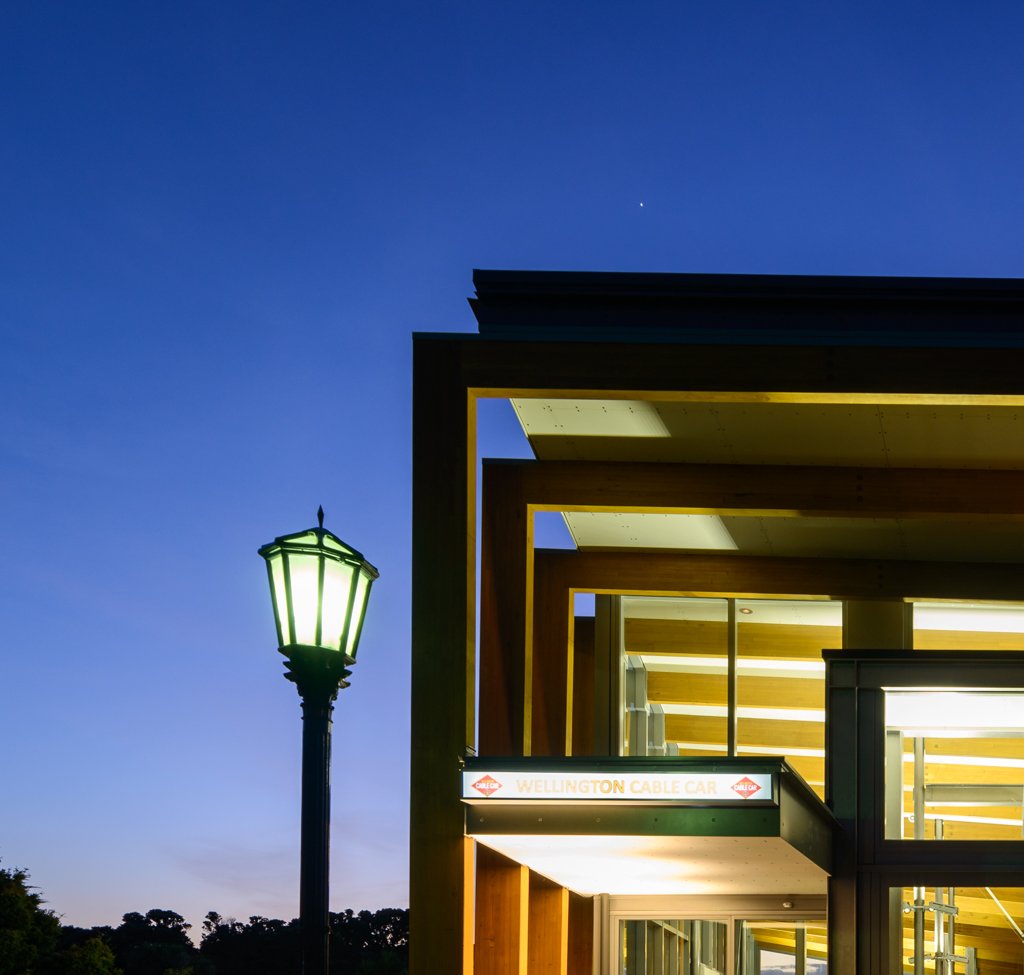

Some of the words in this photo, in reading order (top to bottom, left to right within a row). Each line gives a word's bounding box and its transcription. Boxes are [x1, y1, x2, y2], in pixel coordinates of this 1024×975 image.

[516, 779, 625, 793] WELLINGTON
[630, 779, 680, 794] CABLE
[684, 780, 717, 795] CAR
